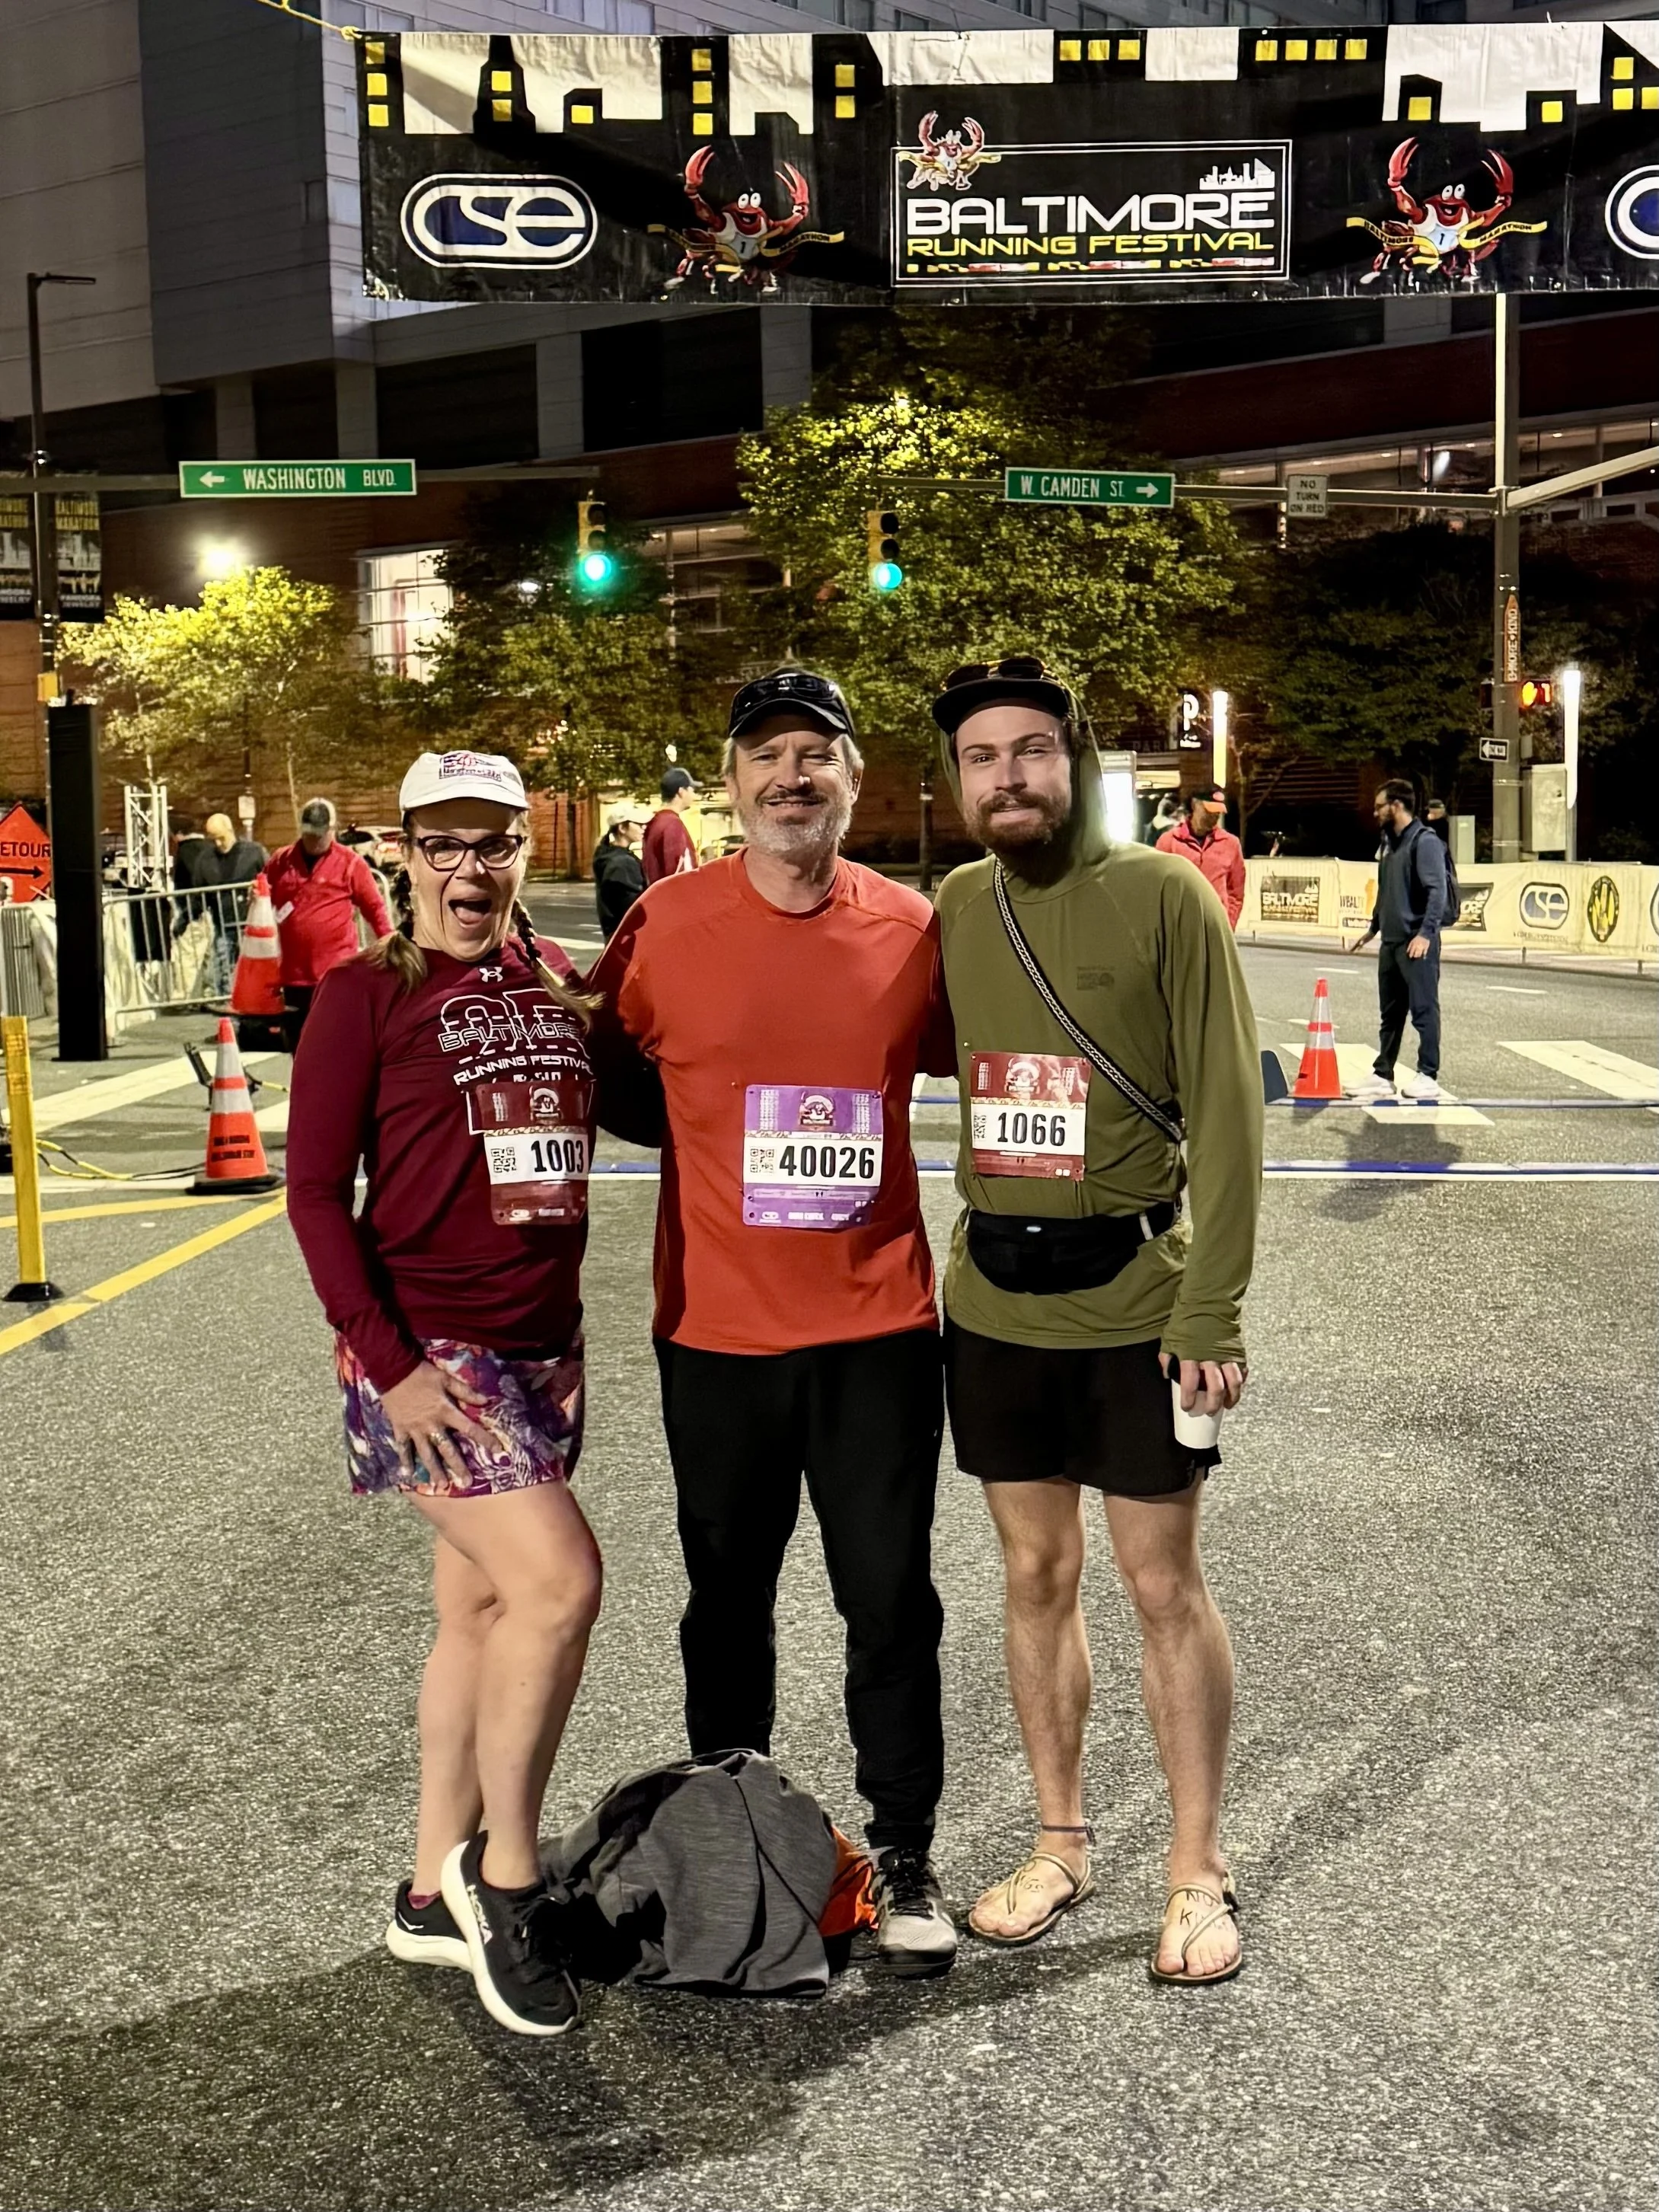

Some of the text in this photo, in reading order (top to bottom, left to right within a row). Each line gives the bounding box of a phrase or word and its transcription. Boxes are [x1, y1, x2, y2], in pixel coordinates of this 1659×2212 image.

[907, 192, 1275, 235] BALTIMORE
[907, 231, 1275, 257] RUNNING FESTIVAL
[243, 468, 397, 490] WASHINGTON BLVD.
[1041, 476, 1100, 498] CAMDEN
[1300, 480, 1316, 489] NO
[1297, 492, 1319, 500] TURN
[1290, 503, 1325, 513] ON RED
[0, 841, 51, 857] ETOUR
[1262, 892, 1319, 907] BALTIMORE
[453, 1055, 528, 1086] RUNNING
[997, 1112, 1066, 1147] 1066
[531, 1139, 584, 1173] 1003
[780, 1145, 875, 1179] 40026
